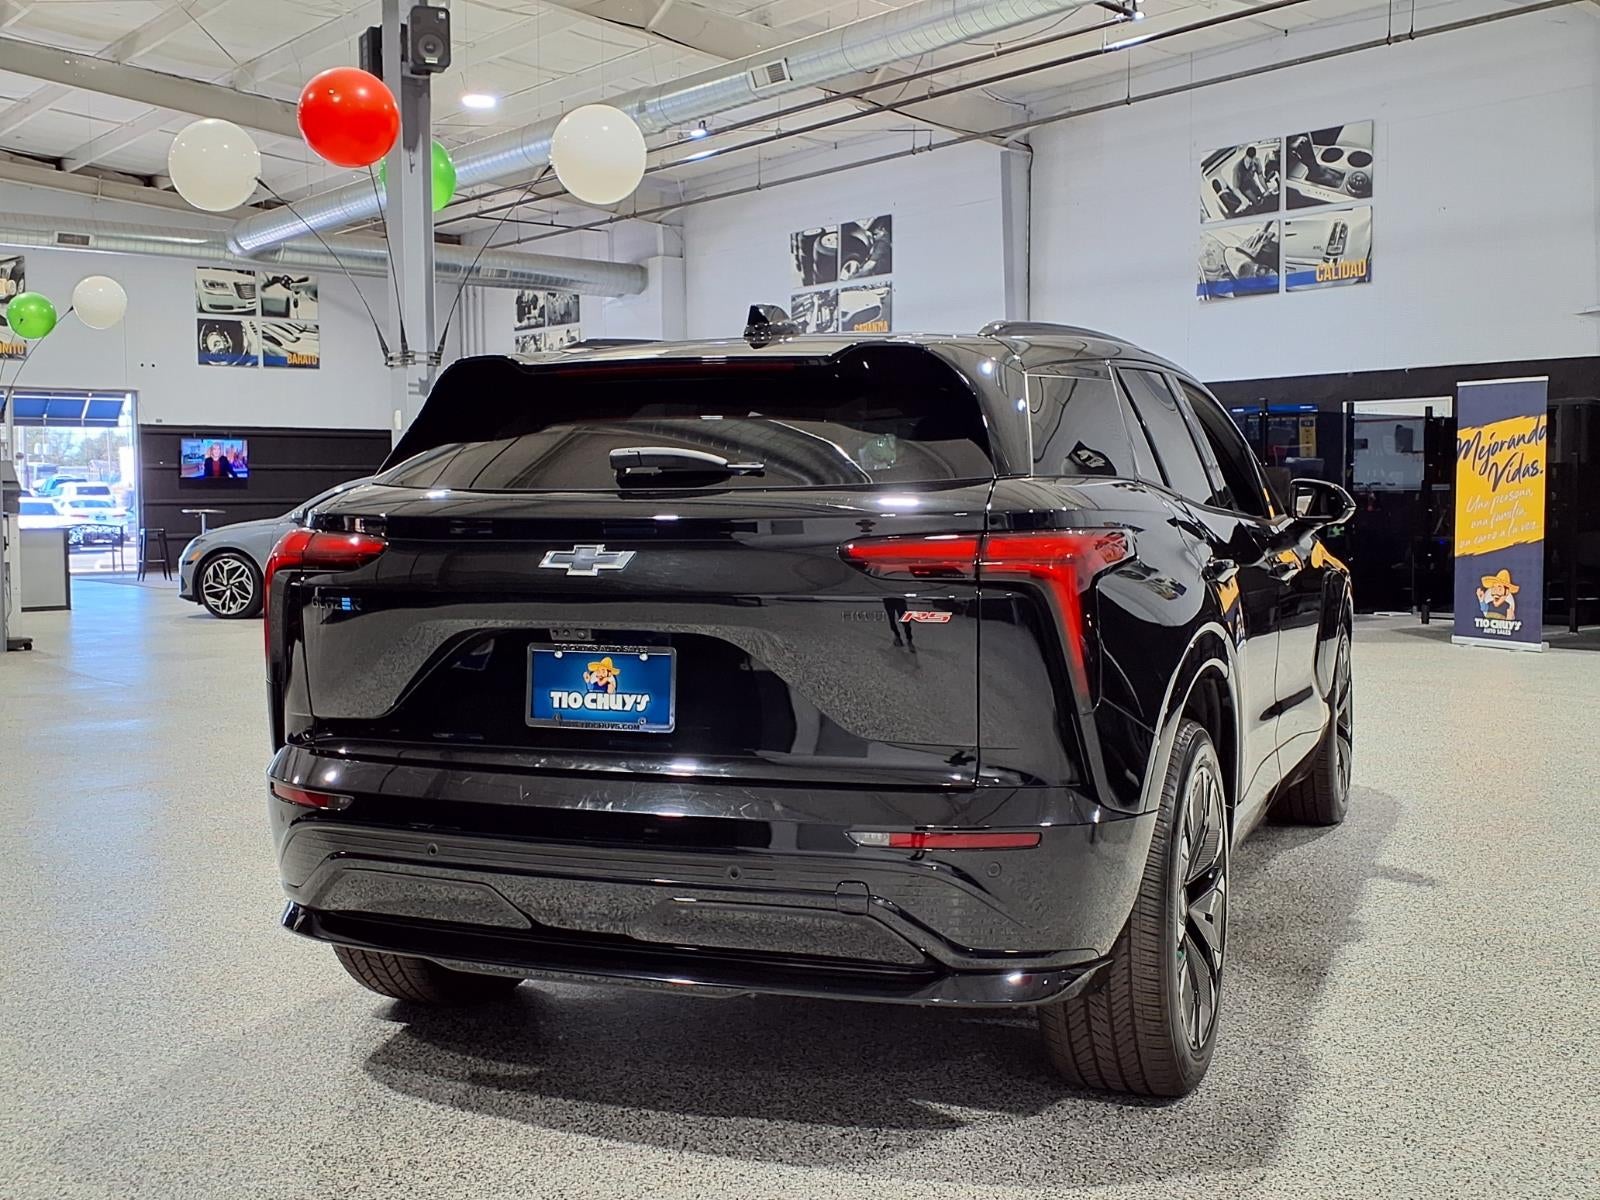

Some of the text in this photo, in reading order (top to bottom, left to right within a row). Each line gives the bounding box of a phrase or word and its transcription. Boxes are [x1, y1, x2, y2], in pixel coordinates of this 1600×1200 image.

[1316, 259, 1366, 281] CALIDAD
[287, 352, 317, 365] BARATO
[1457, 416, 1546, 476] Mejorando
[1487, 452, 1543, 492] Vidas.
[898, 611, 952, 623] RS
[1474, 618, 1489, 627] TIO
[550, 691, 650, 712] TIO CHUY'S
